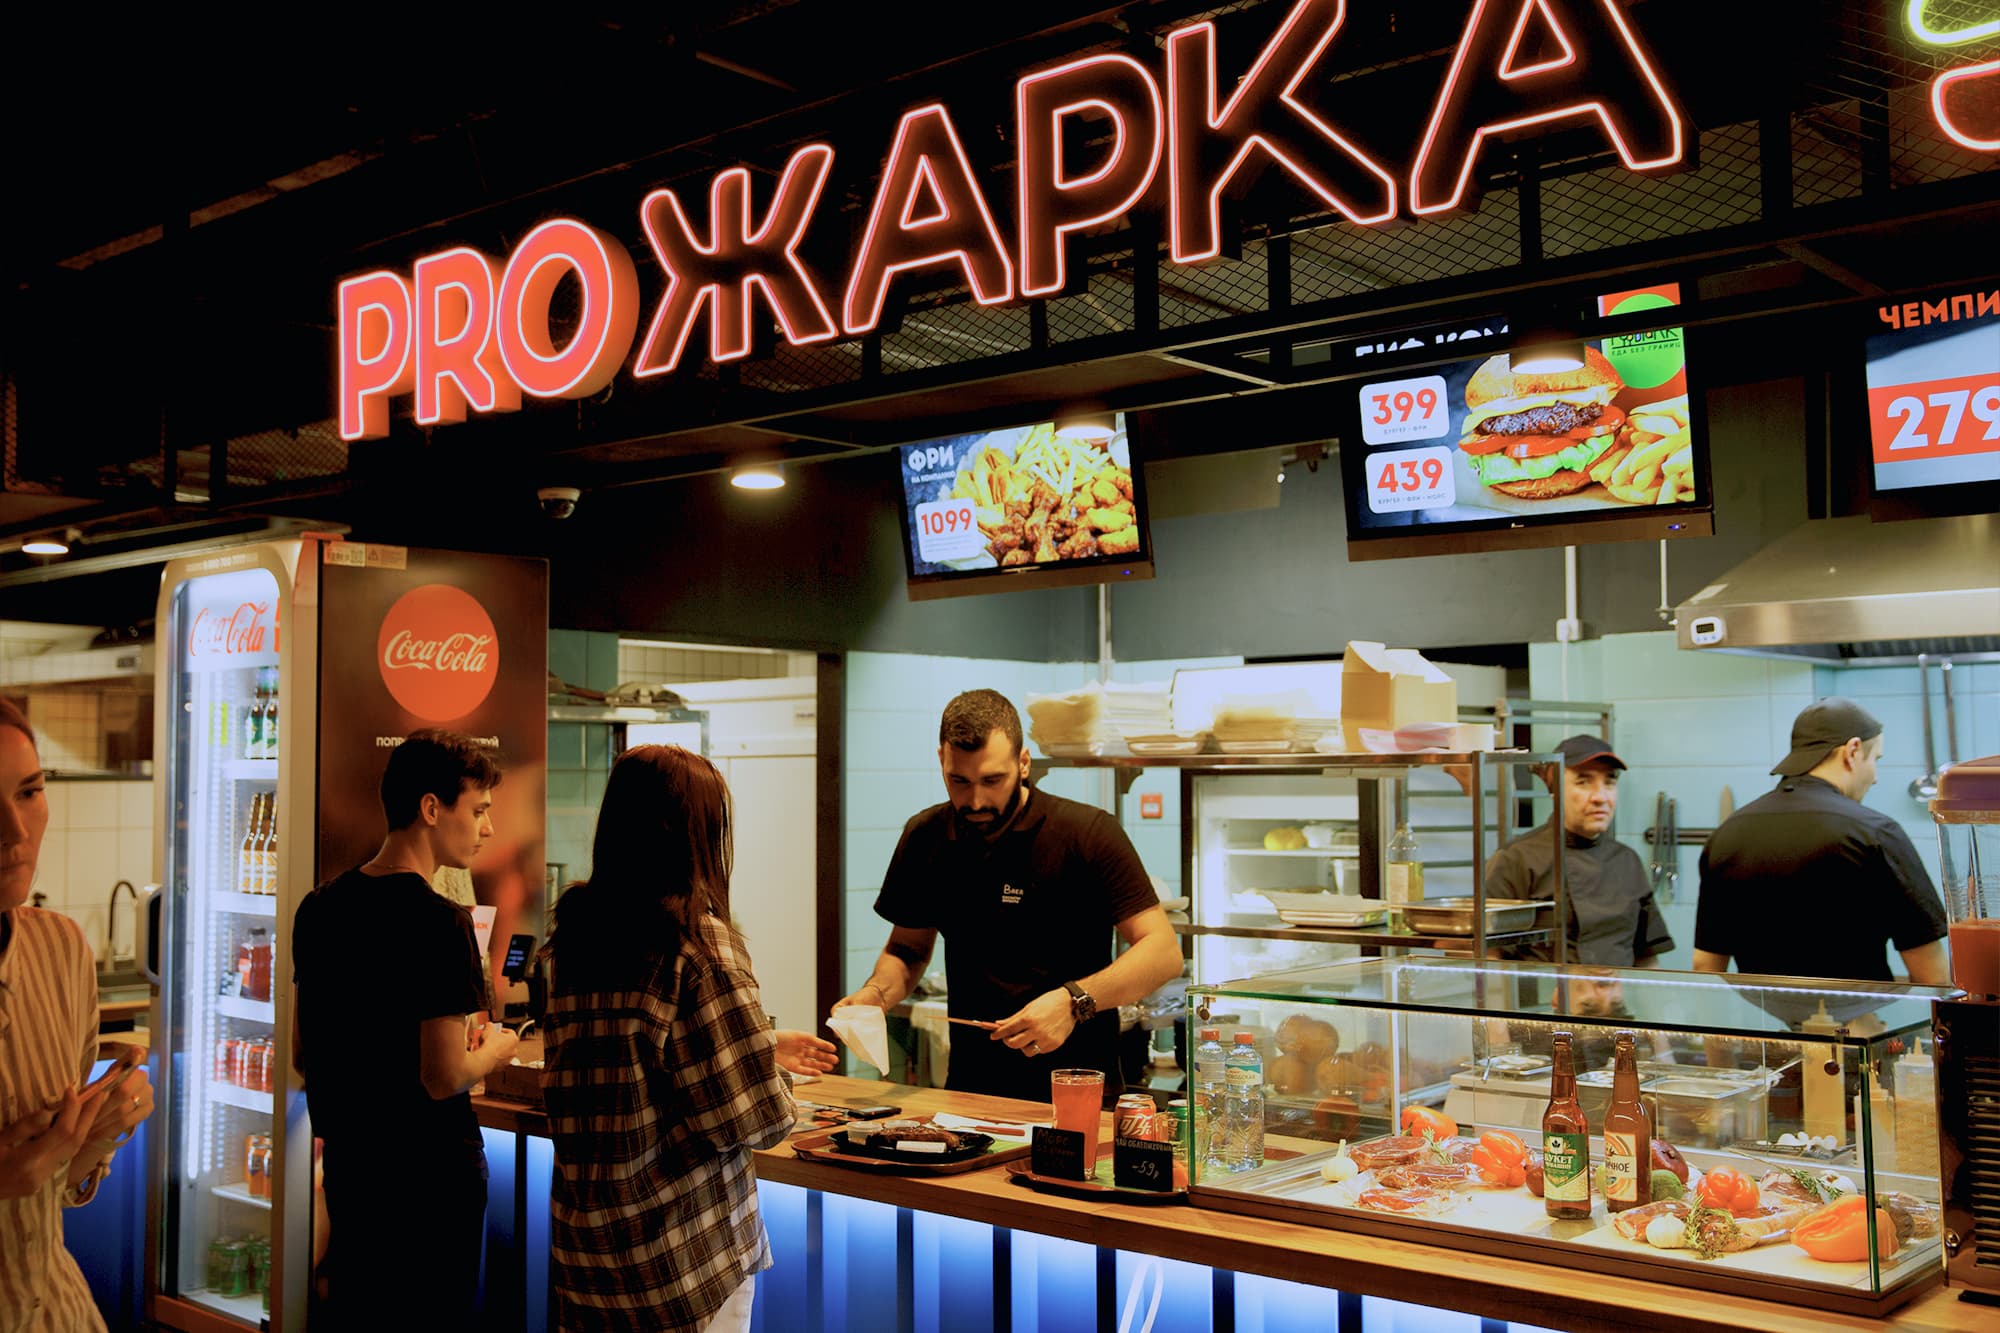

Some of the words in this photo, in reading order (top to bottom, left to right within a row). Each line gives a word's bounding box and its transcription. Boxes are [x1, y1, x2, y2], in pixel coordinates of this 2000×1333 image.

[1372, 388, 1437, 425] 399
[1887, 385, 2000, 450] 279
[908, 445, 955, 472] ФРИ
[1377, 458, 1443, 493] 439
[921, 508, 972, 535] 1099
[384, 629, 492, 672] Coca-Cola
